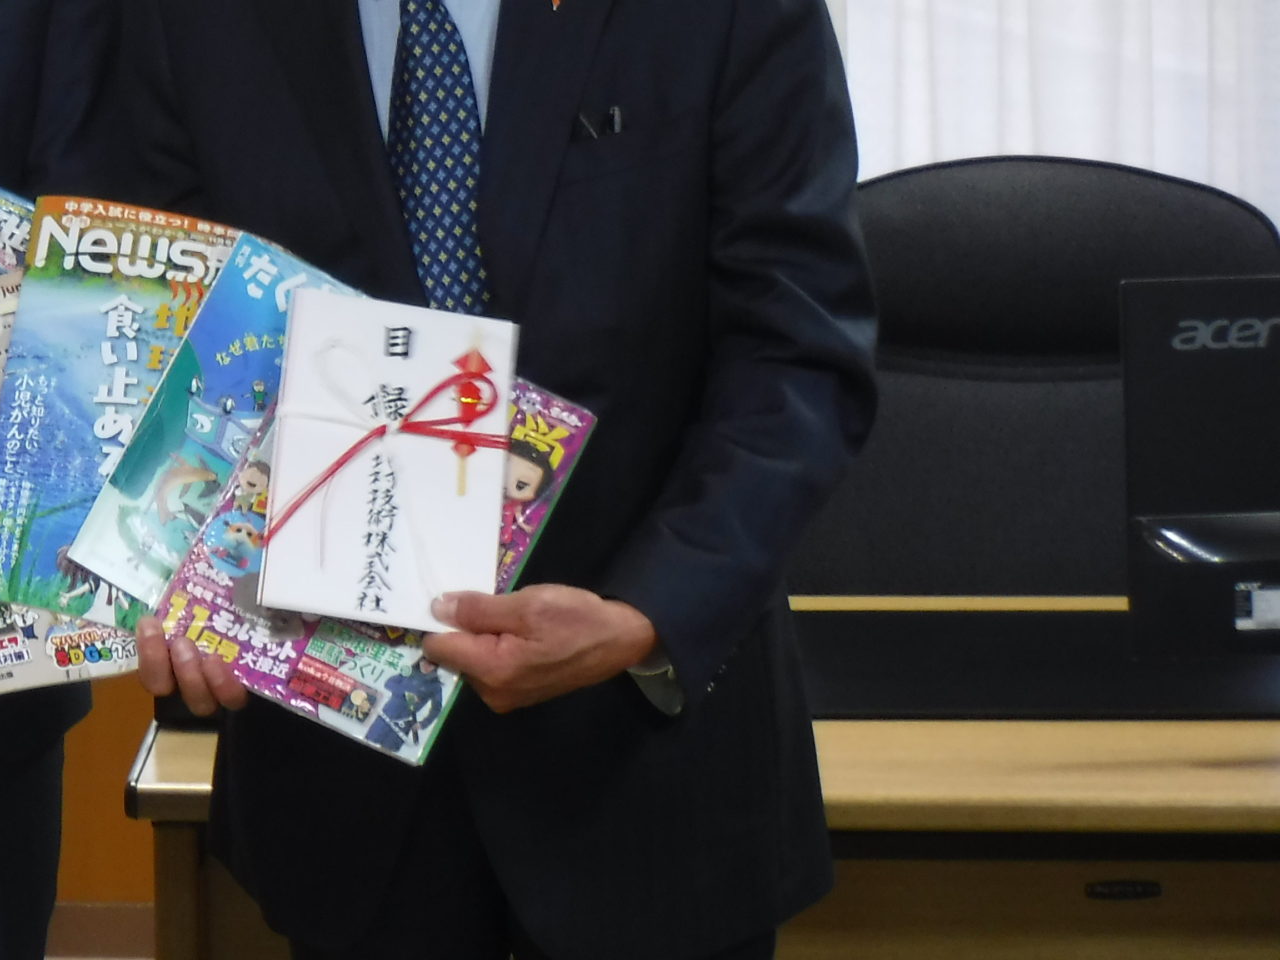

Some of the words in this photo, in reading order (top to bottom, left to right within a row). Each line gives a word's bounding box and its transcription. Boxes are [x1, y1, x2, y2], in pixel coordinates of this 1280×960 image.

[1171, 317, 1280, 351] acer
[4, 373, 34, 473] 小児がんのこと
